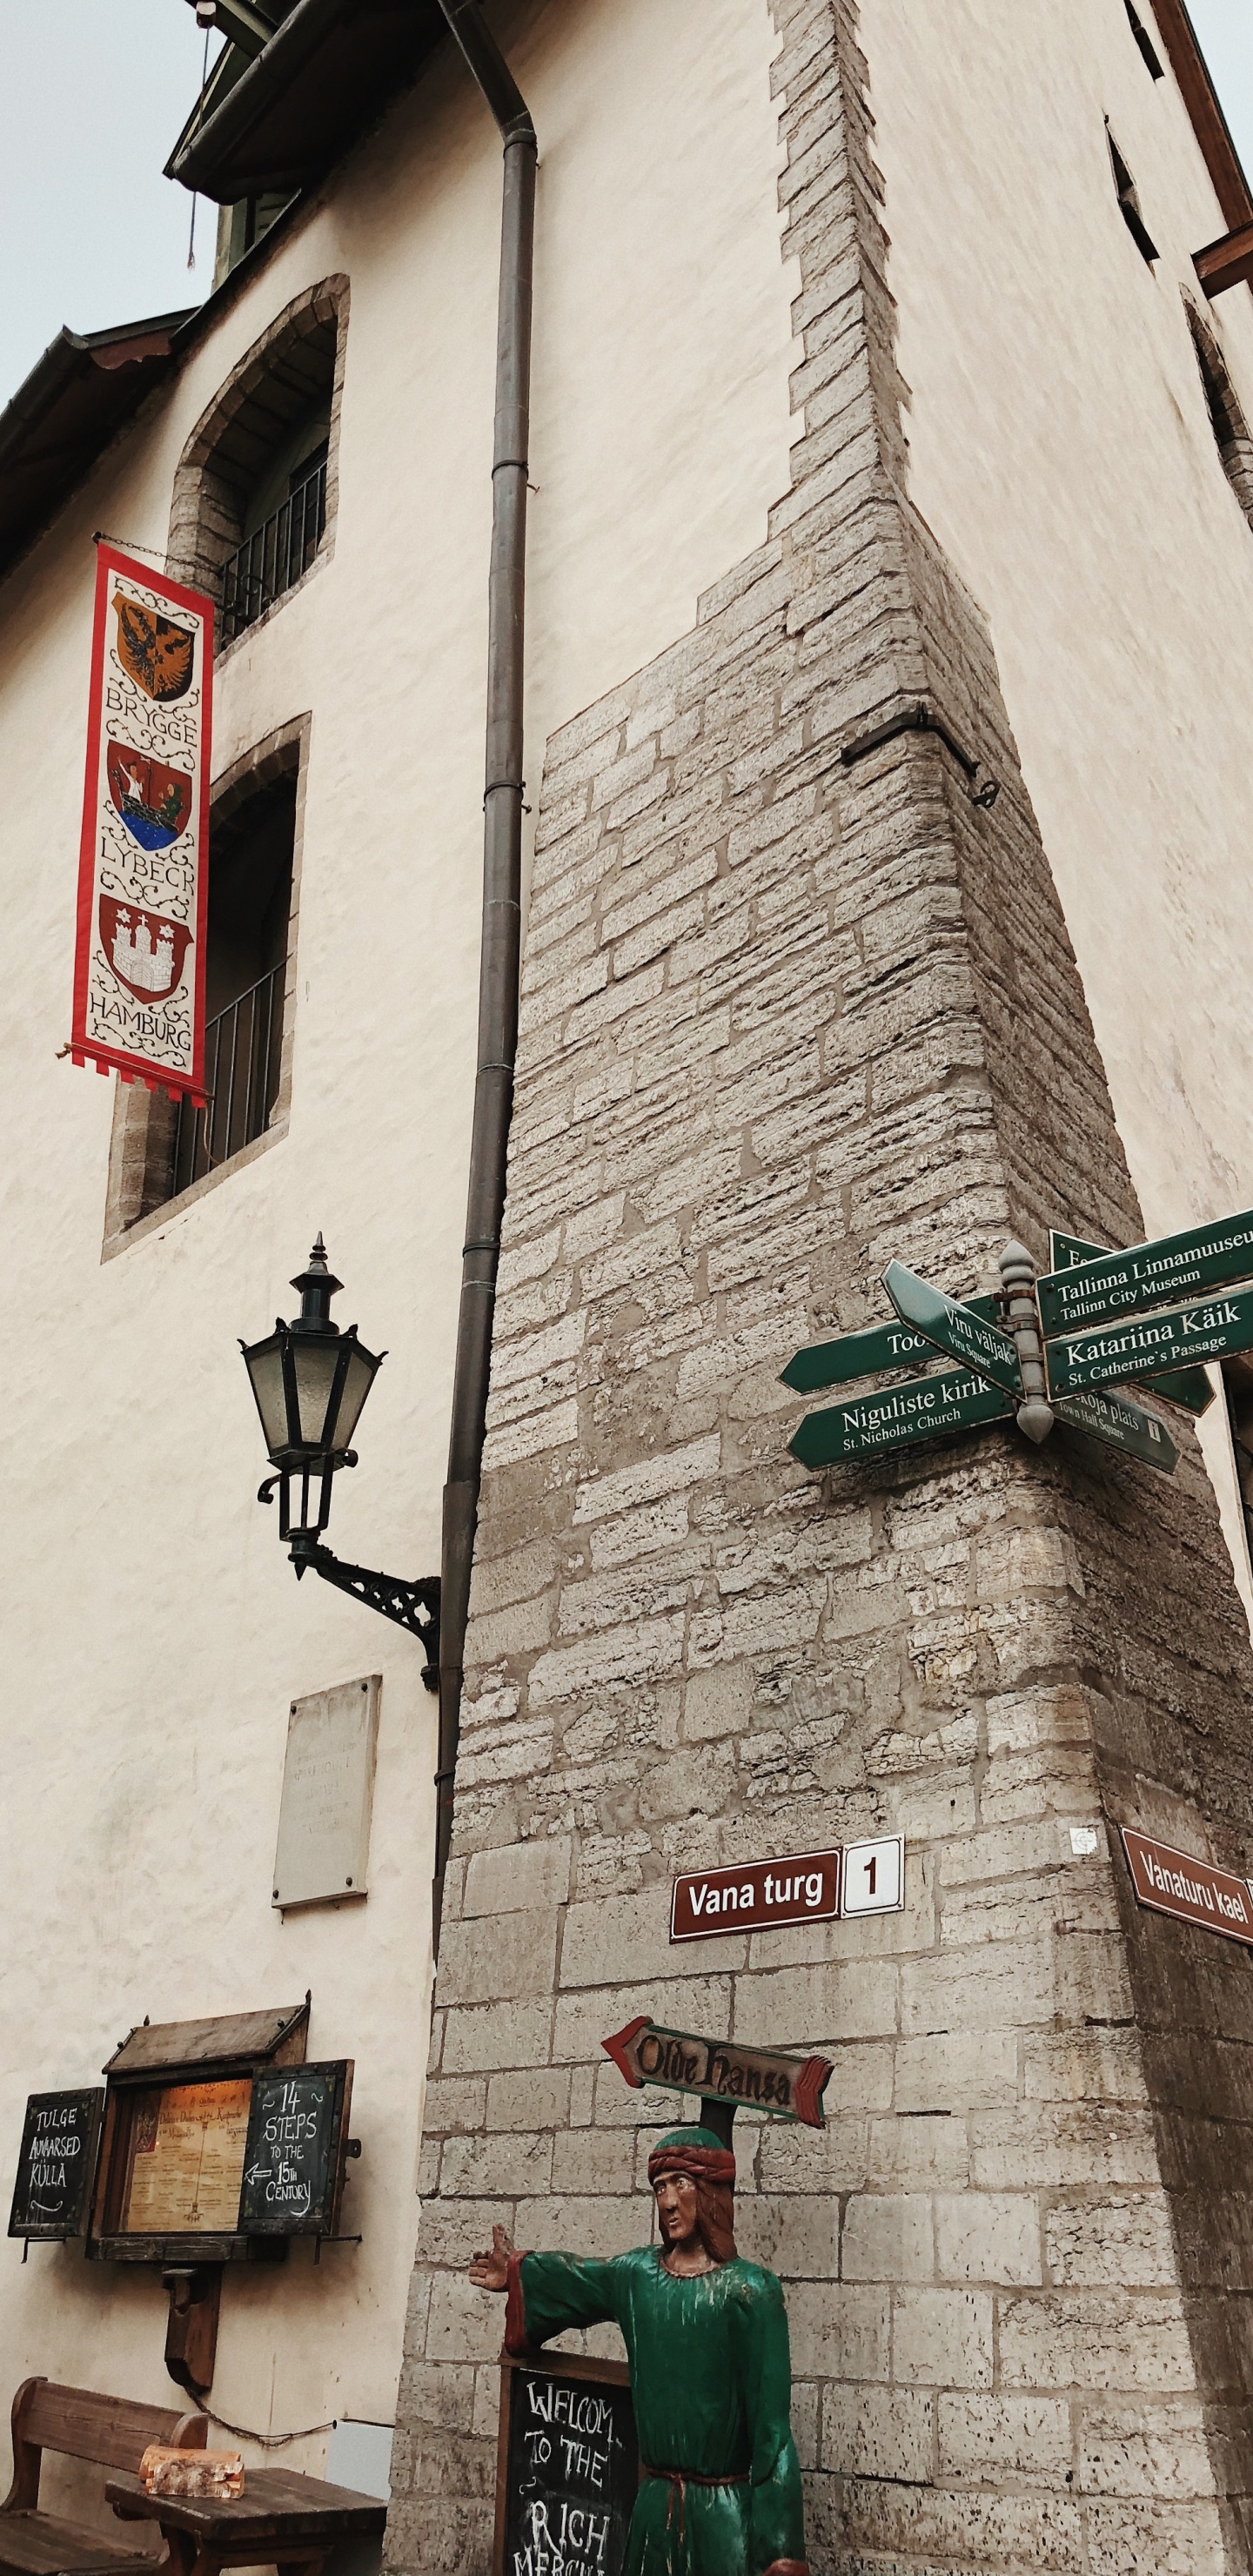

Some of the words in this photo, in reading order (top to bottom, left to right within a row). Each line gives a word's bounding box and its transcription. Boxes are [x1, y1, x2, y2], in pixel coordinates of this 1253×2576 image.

[106, 687, 198, 748] BRYGGE
[101, 835, 195, 896] LYBECK
[89, 991, 191, 1051] HAMBURG
[1058, 1269, 1129, 1303] Tallinna
[1060, 1298, 1107, 1321] Tallinn
[1109, 1287, 1138, 1309] City
[1142, 1269, 1202, 1297] Museum
[943, 1304, 973, 1339] Viru
[975, 1330, 1012, 1366] väljak
[948, 1331, 966, 1352] Viru
[965, 1343, 991, 1369] Square
[1065, 1325, 1175, 1367] Katariina
[1179, 1302, 1243, 1336] Käik
[1069, 1372, 1087, 1386] St.
[1170, 1335, 1228, 1361] Passage
[841, 1392, 935, 1432] Niguliste
[940, 1374, 992, 1404] kirik
[1059, 1400, 1081, 1419] Town
[1082, 1410, 1099, 1427] Hall
[1099, 1419, 1125, 1440] Square
[1109, 1404, 1139, 1431] plats
[843, 1439, 859, 1451] St.
[860, 1422, 914, 1446] Nicholas
[917, 1408, 962, 1430] Church
[688, 1883, 754, 1916] Vana
[763, 1873, 823, 1907] turg
[863, 1856, 876, 1895] 1
[1139, 1850, 1216, 1911] Vanaturu
[1212, 1882, 1250, 1924] kael
[636, 2034, 697, 2085] Olde
[37, 2107, 77, 2131] TULGE
[279, 2080, 301, 2114] 14
[262, 2111, 318, 2142] STEPS
[29, 2158, 67, 2188] KÜLLA
[270, 2145, 281, 2159] TO
[285, 2144, 305, 2160] THE
[524, 2429, 552, 2464] TO
[560, 2434, 608, 2488] THE
[530, 2499, 610, 2562] RICH
